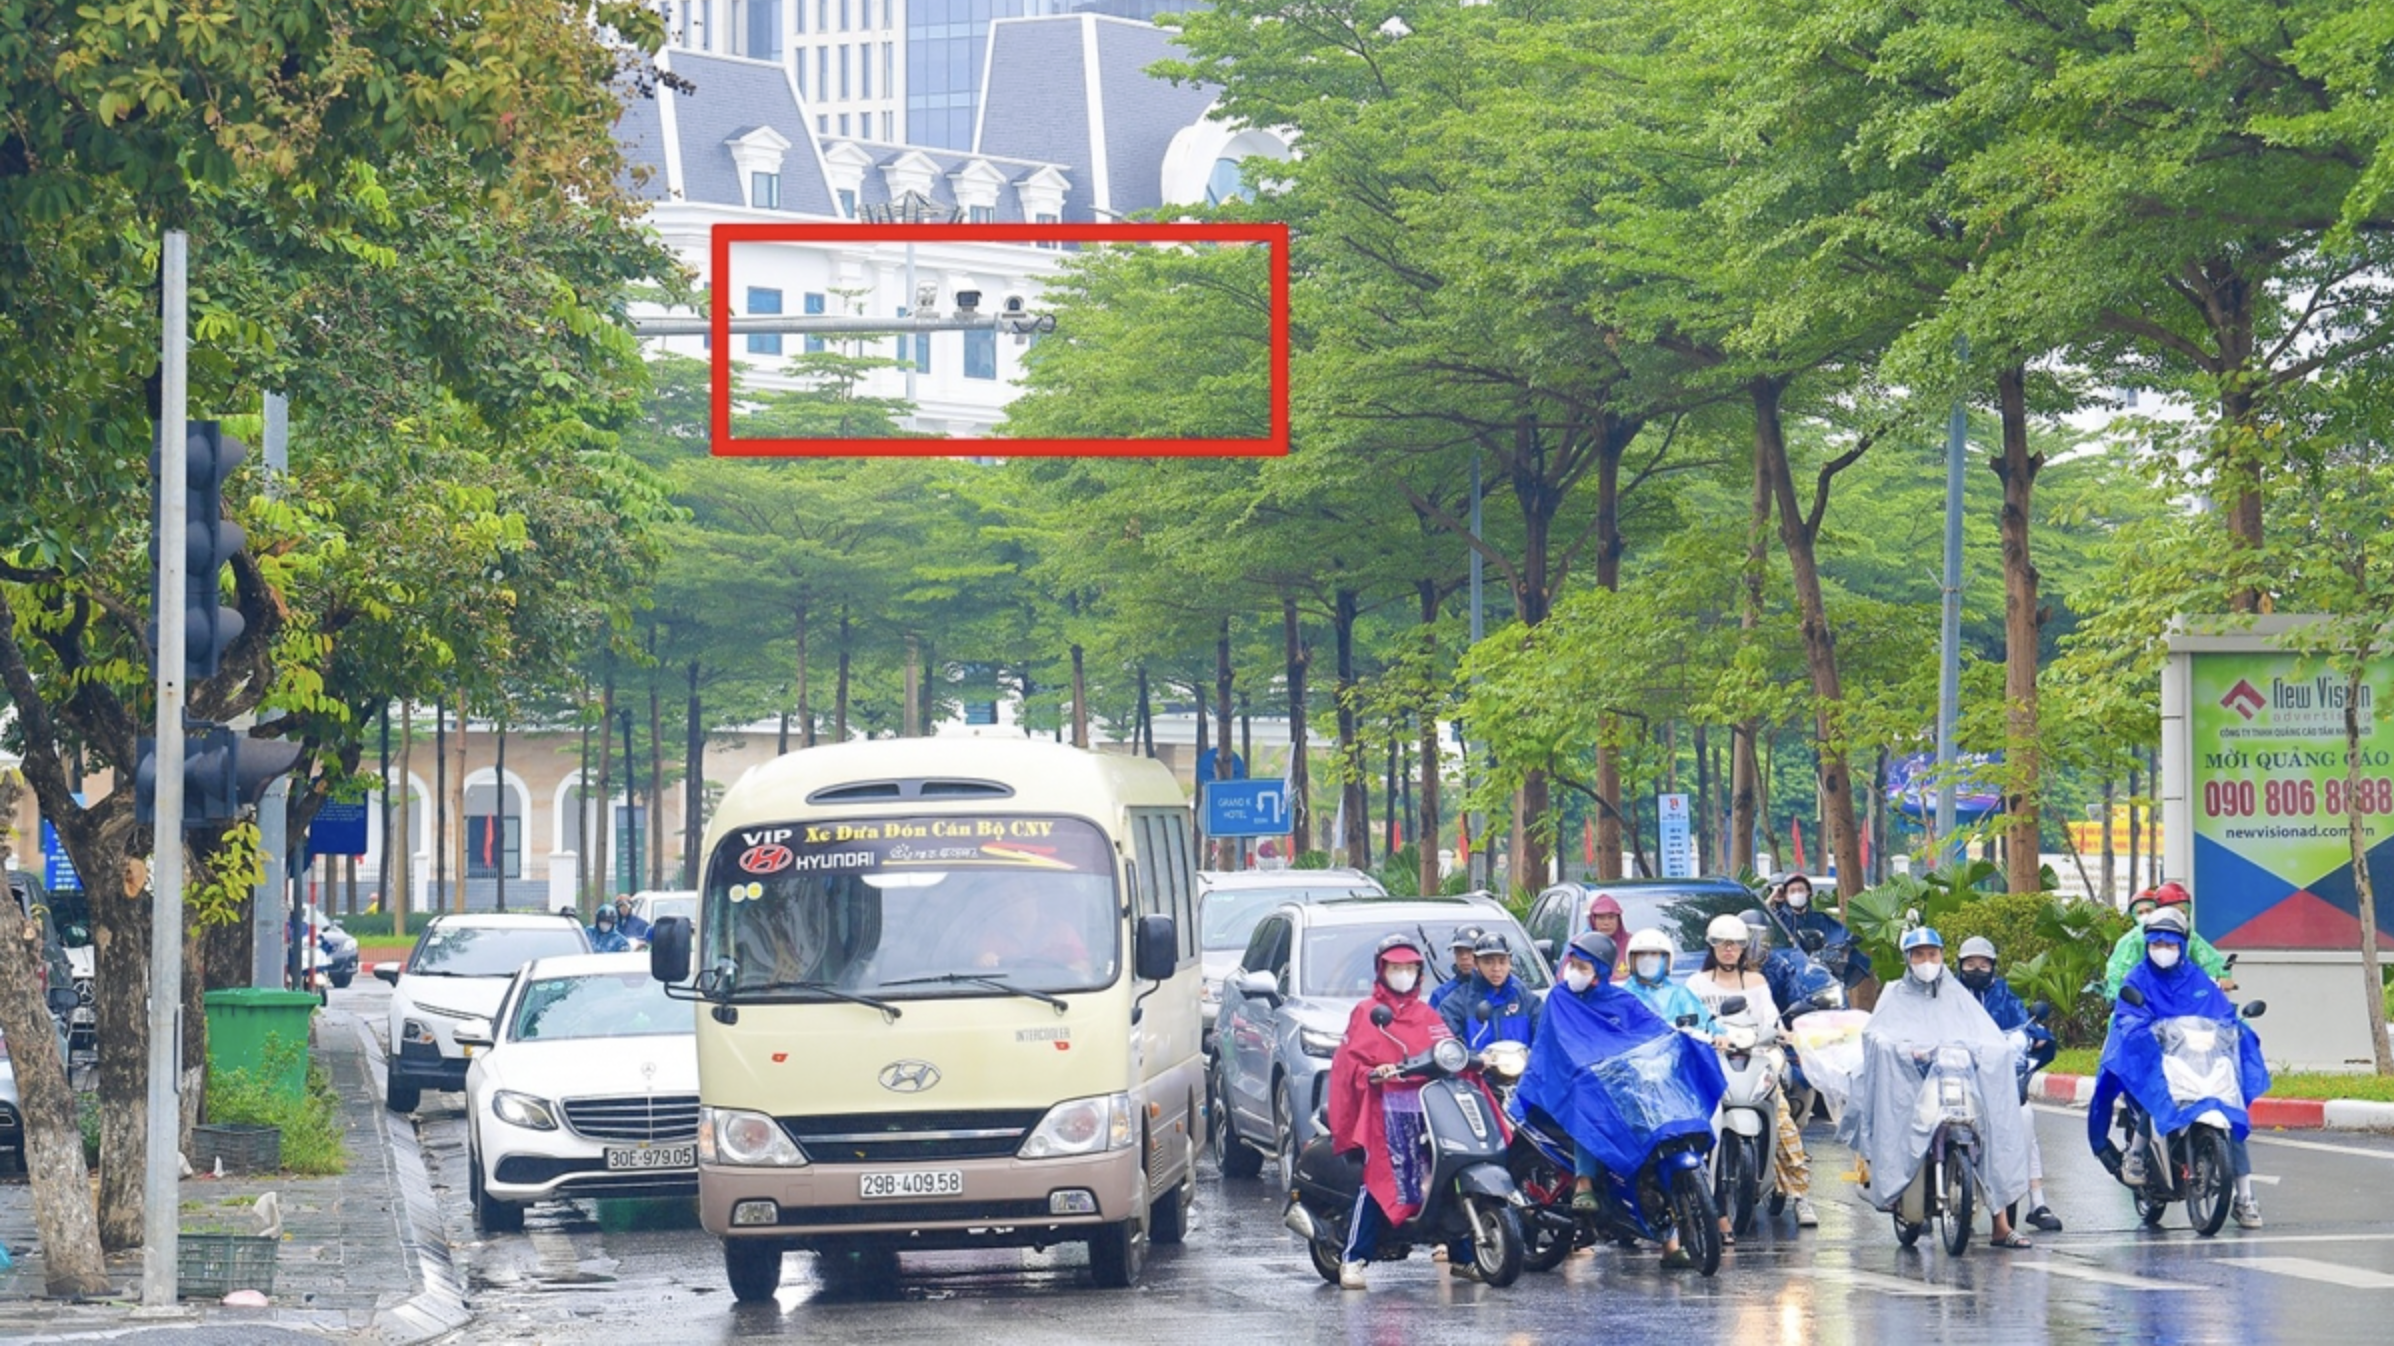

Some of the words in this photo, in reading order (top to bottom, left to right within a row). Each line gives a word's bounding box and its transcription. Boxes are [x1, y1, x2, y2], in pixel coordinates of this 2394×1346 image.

[2273, 678, 2311, 708] New
[2317, 676, 2371, 709] Visin
[2273, 712, 2372, 723] advertisg
[2205, 750, 2249, 769] MỜI
[2256, 747, 2335, 770] QUẢNG
[2204, 780, 2256, 817] 090
[2265, 779, 2316, 816] 806
[742, 829, 793, 846] VIP
[805, 827, 830, 843] Xe
[836, 825, 878, 841] Đưa
[884, 823, 927, 838] Đón
[932, 821, 971, 836] Cán
[977, 820, 1005, 841] Bộ
[1010, 821, 1054, 837] CNV
[796, 851, 875, 871] HYUNDAI
